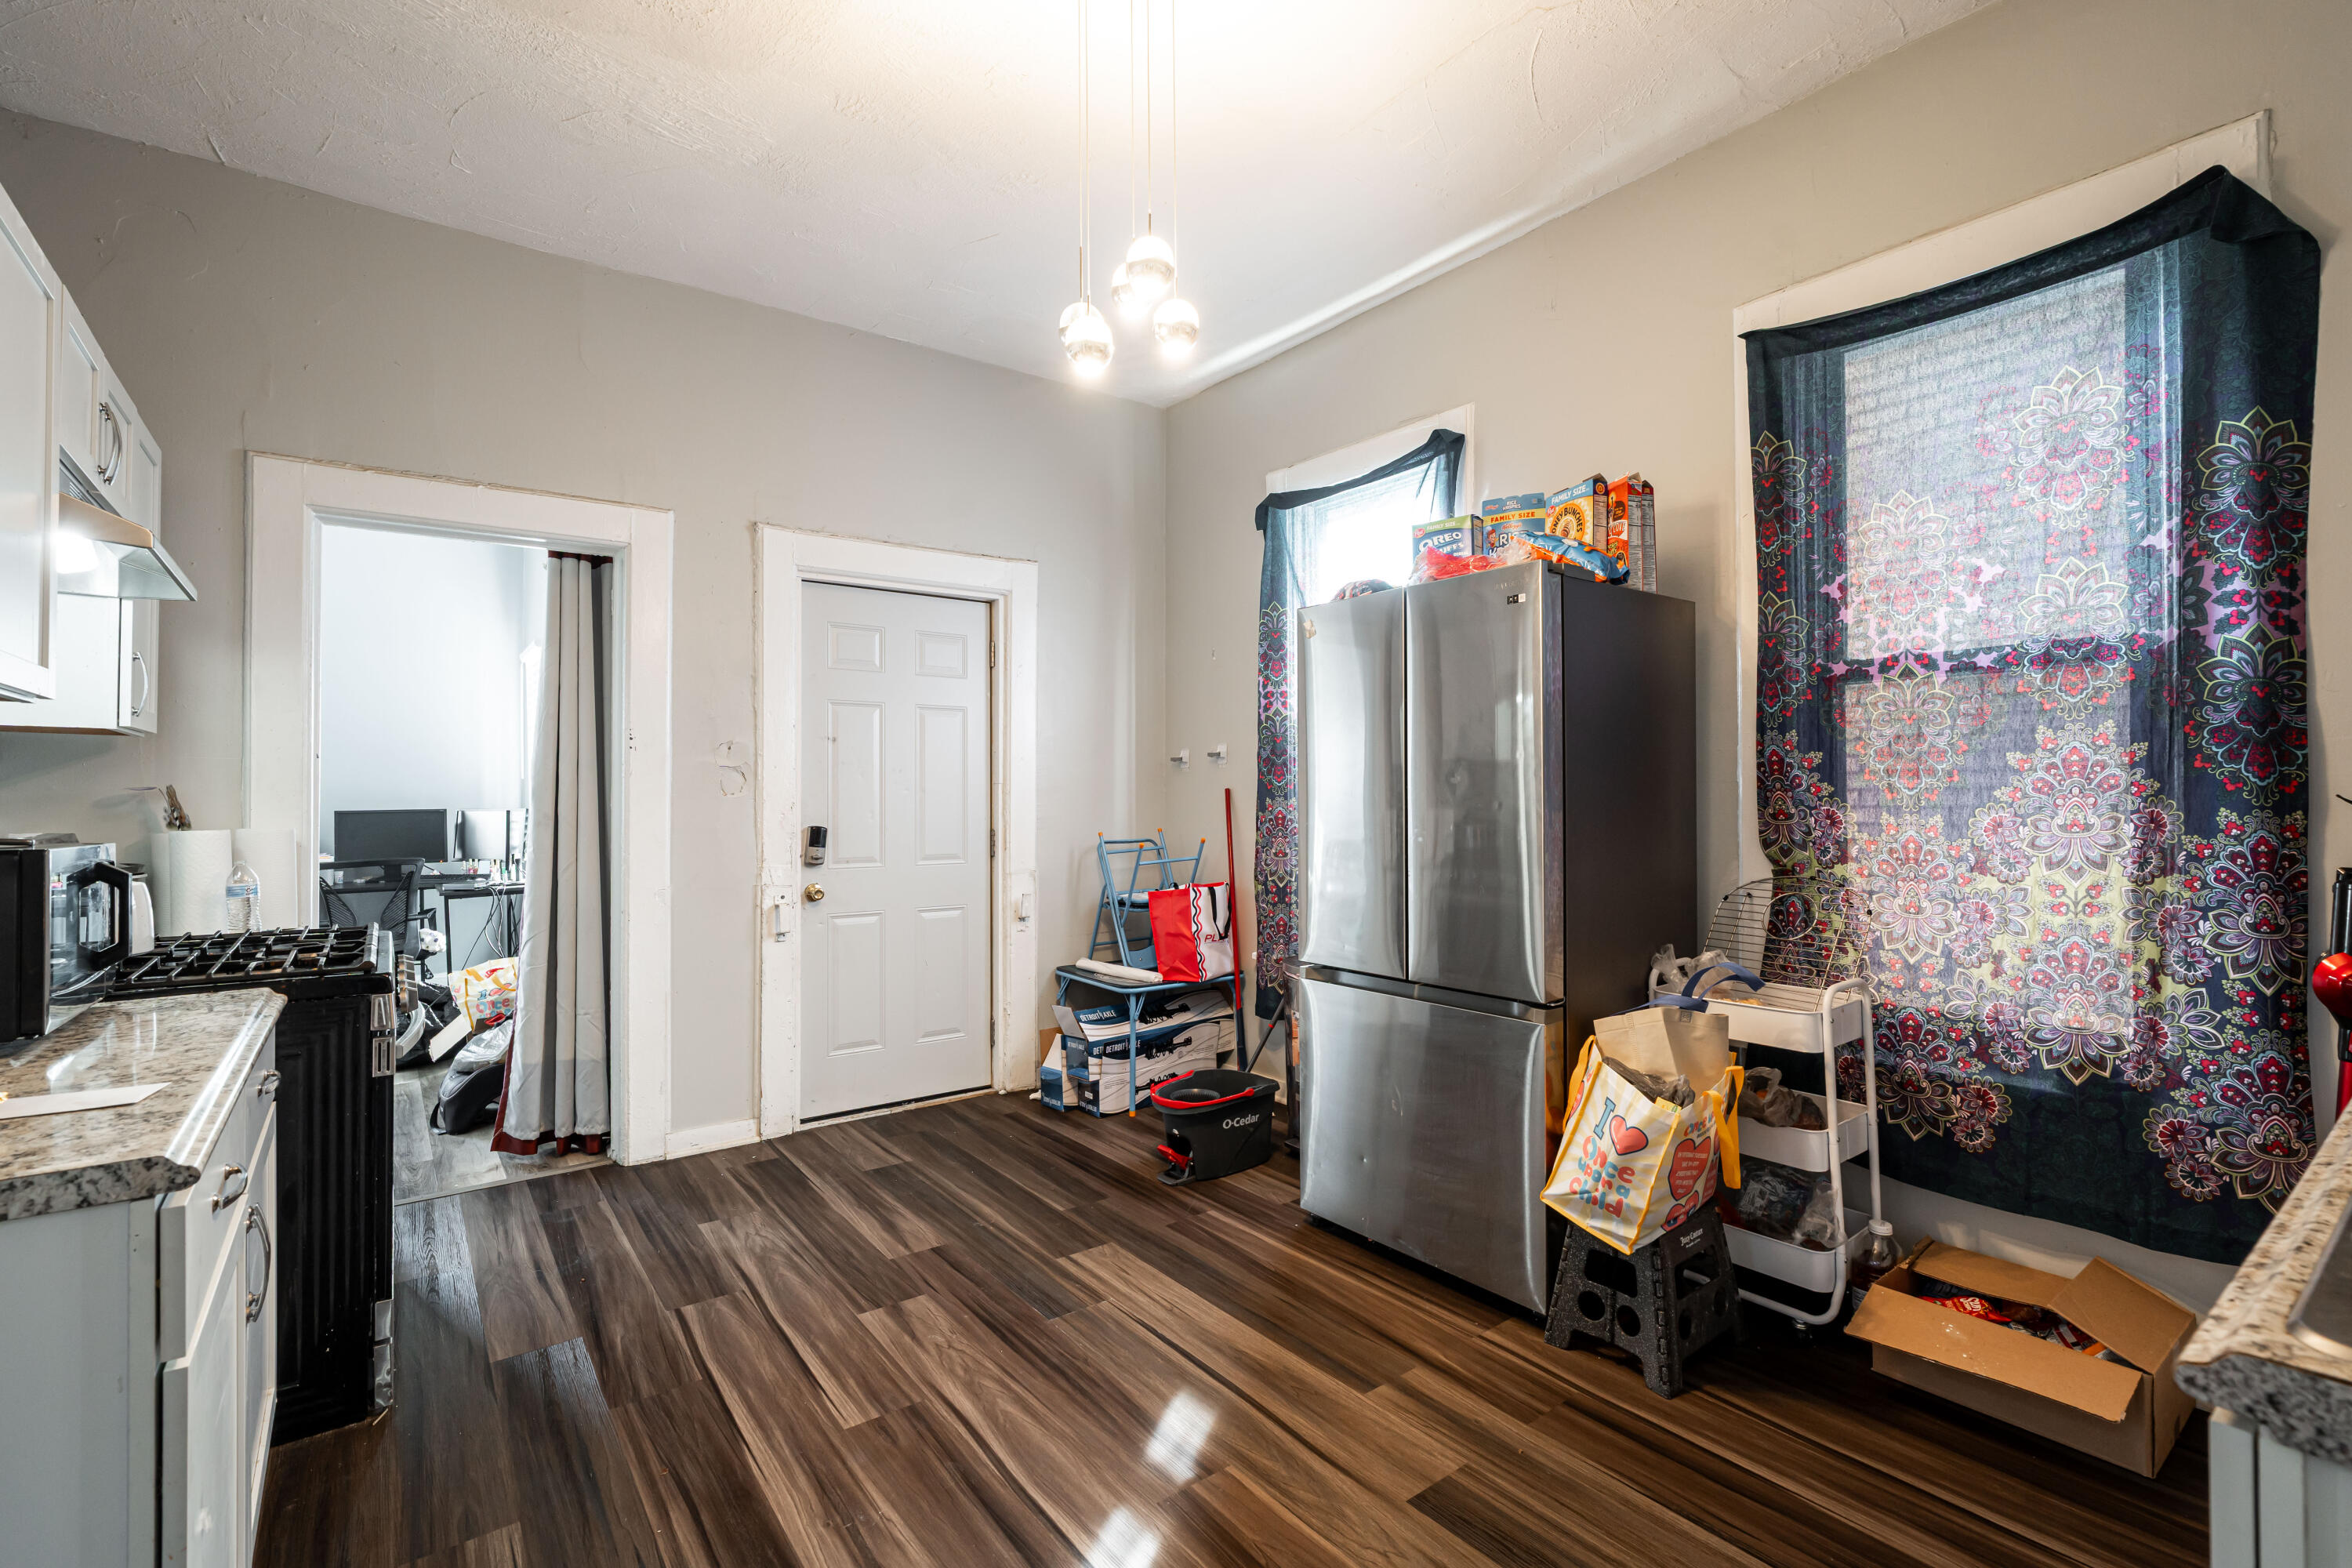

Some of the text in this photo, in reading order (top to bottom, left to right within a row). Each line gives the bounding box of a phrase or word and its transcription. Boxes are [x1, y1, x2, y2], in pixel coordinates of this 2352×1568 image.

[1552, 485, 1586, 504] FAMILY SIZE
[1490, 514, 1515, 524] FAMILY
[1552, 510, 1563, 534] ONEY
[1563, 506, 1583, 532] BUNCHES
[1418, 532, 1462, 554] OREO
[1080, 1010, 1116, 1022] DETROIT AXLE
[1105, 1043, 1126, 1054] DETROIT
[1222, 1113, 1260, 1129] O-Cedar
[1582, 1135, 1635, 1185] Once
